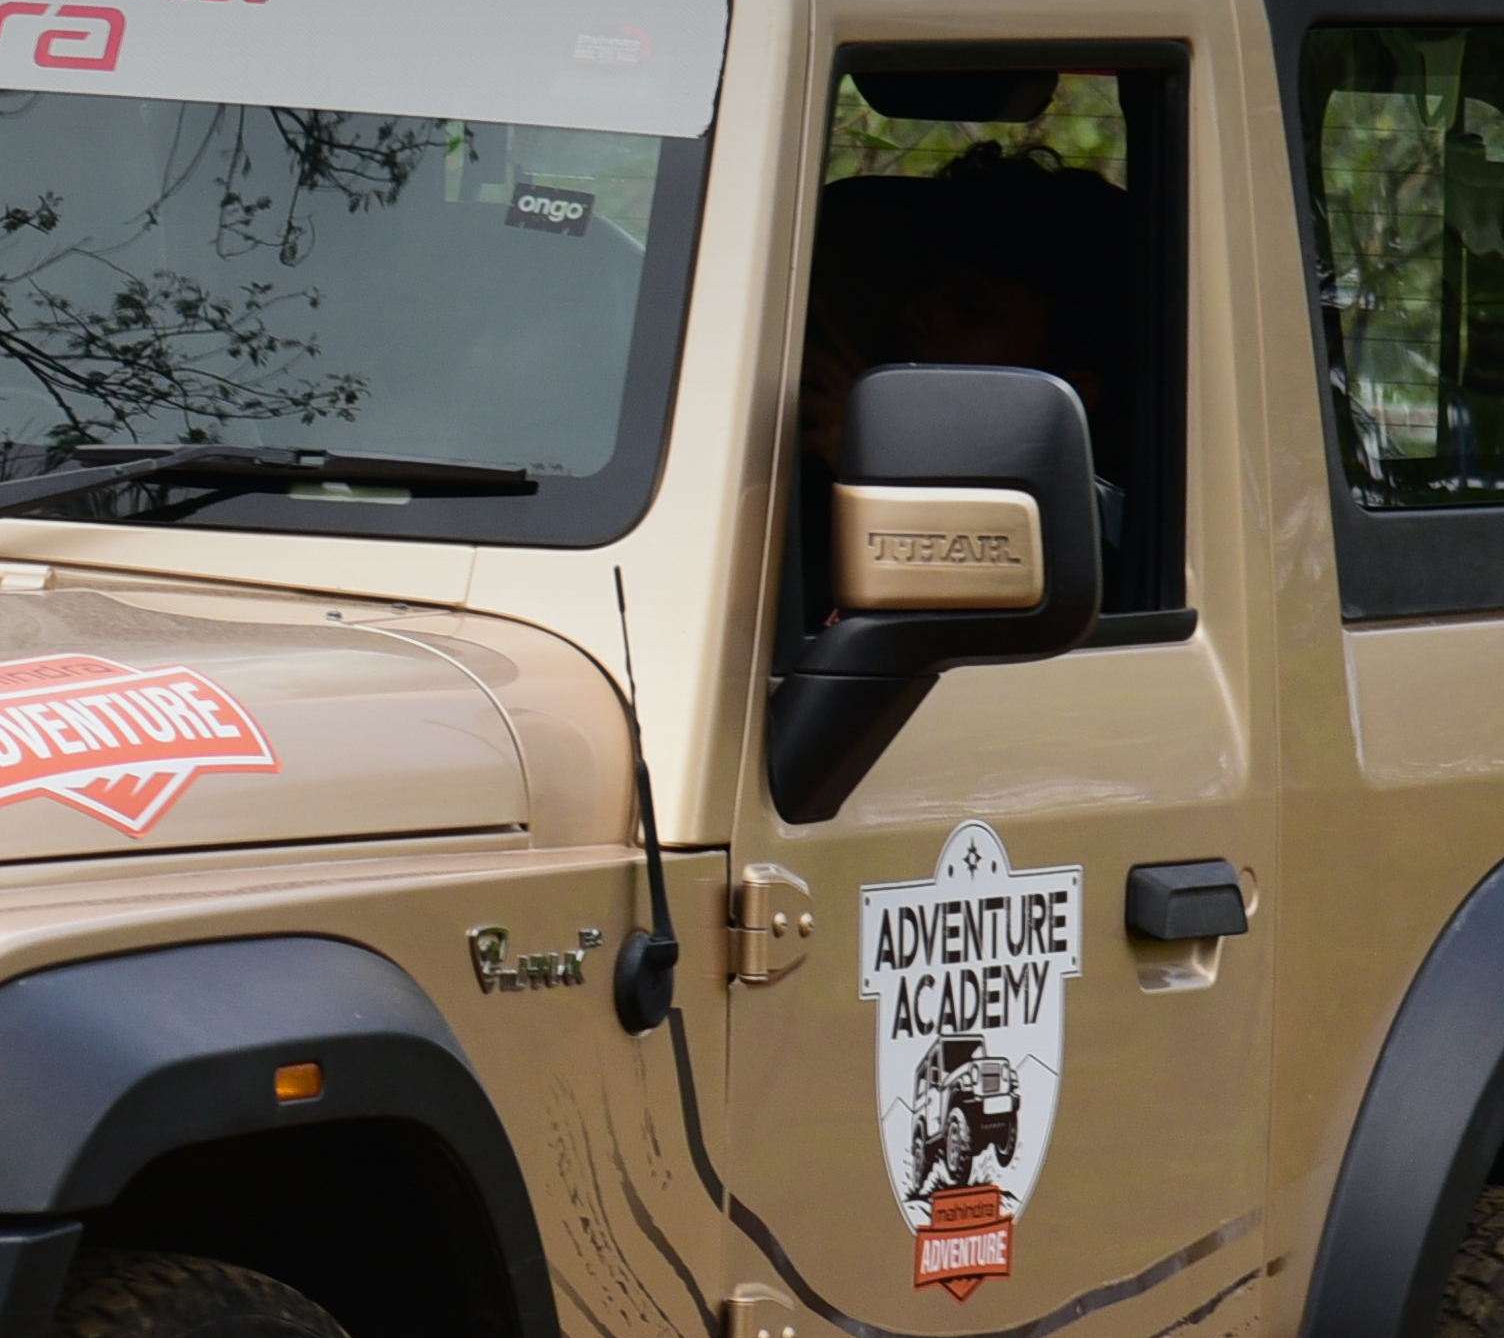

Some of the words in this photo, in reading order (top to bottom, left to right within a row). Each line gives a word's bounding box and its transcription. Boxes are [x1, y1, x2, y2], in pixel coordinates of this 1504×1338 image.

[517, 193, 585, 223] ongo
[866, 530, 1023, 568] THAR
[873, 890, 1070, 972] ADVENTURE
[891, 960, 1051, 1040] ACADEMY
[935, 1198, 997, 1223] mahindra
[920, 1229, 1008, 1275] ADVENTURE
